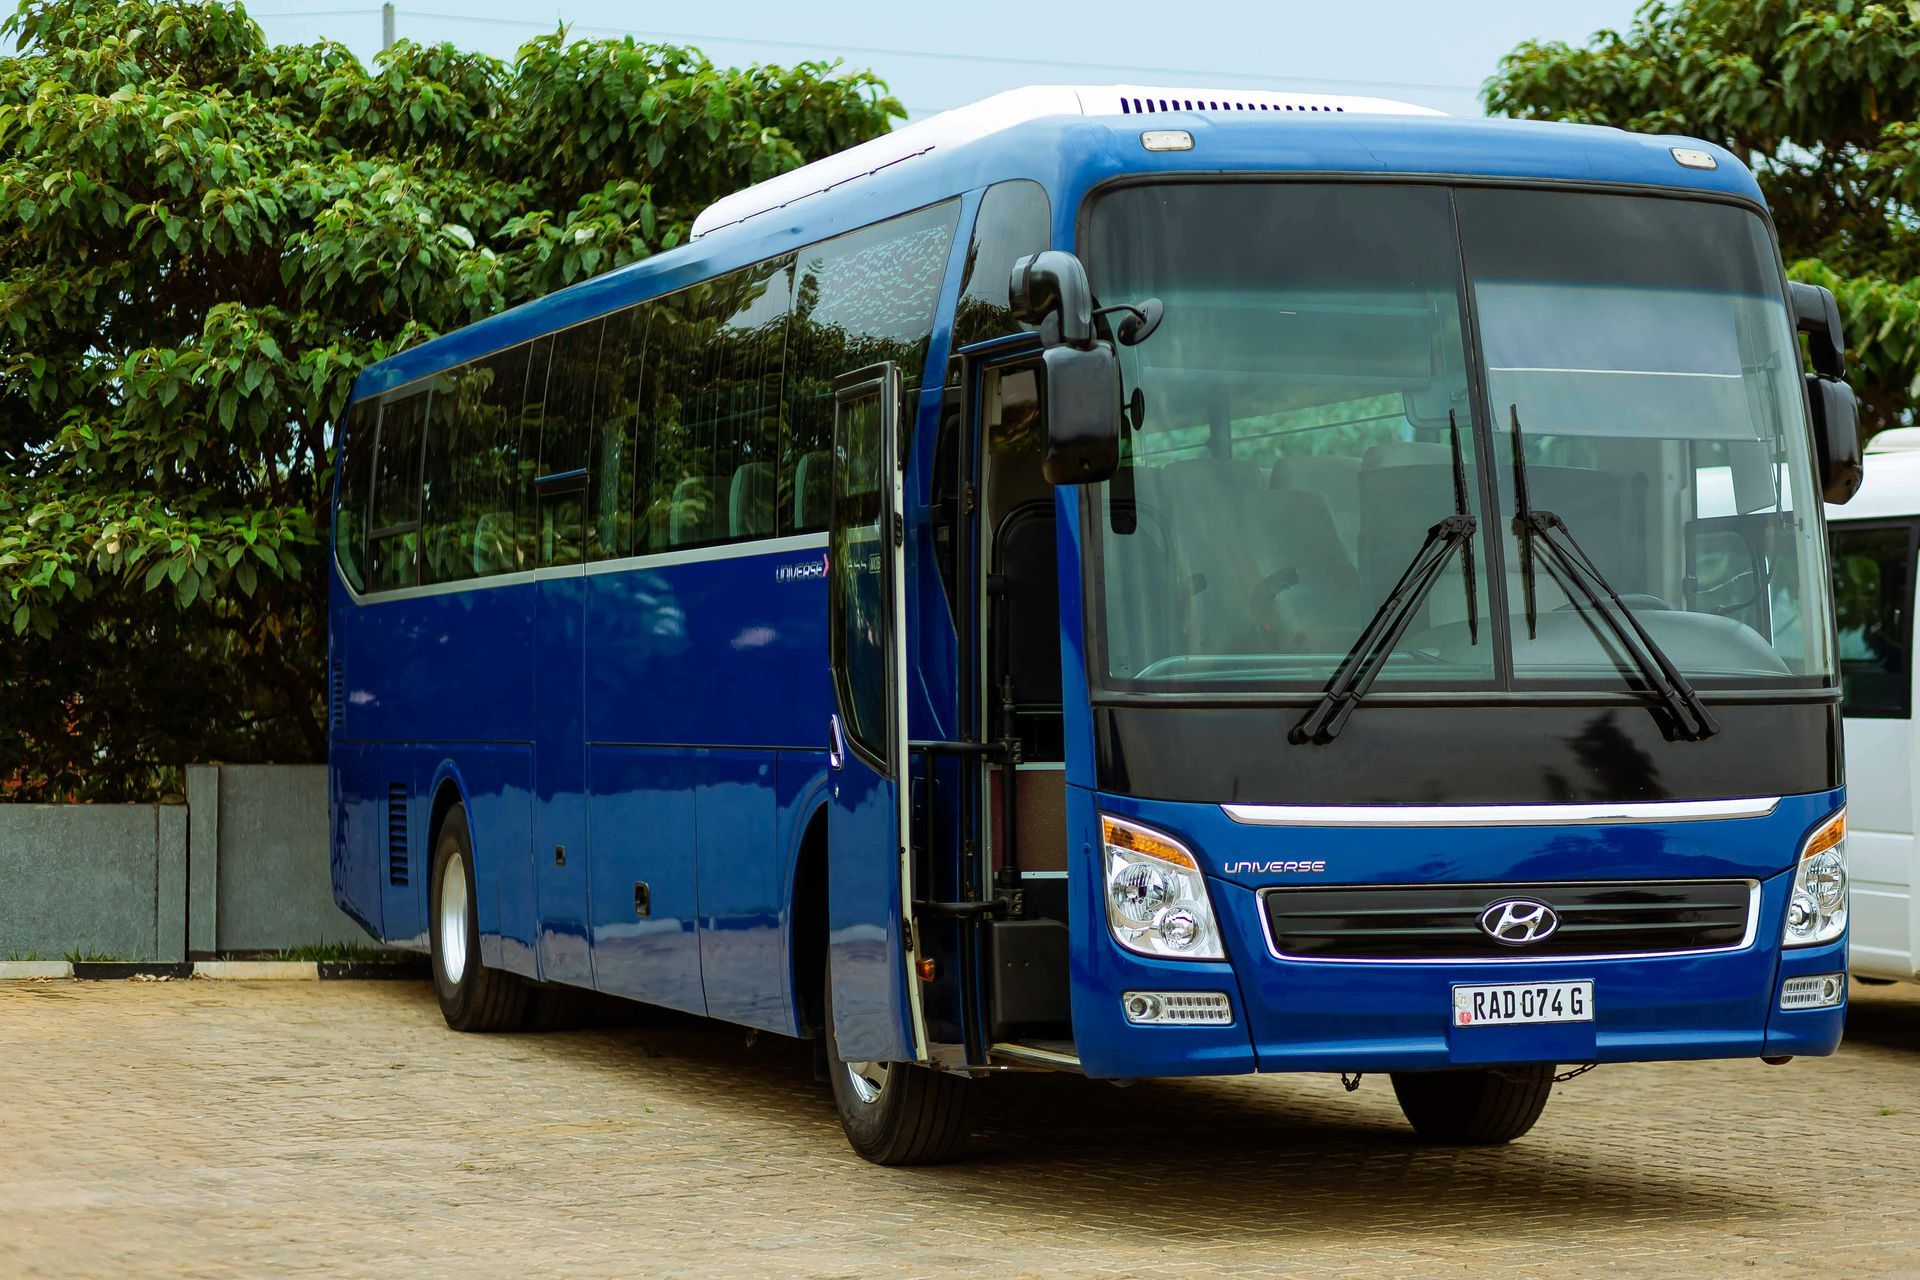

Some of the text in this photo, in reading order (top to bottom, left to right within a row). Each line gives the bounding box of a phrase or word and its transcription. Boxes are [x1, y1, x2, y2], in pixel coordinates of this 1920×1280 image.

[775, 561, 823, 582] UNIVERSE
[1224, 860, 1326, 874] UNIVERSE
[1473, 987, 1583, 1020] RAD 074 G
